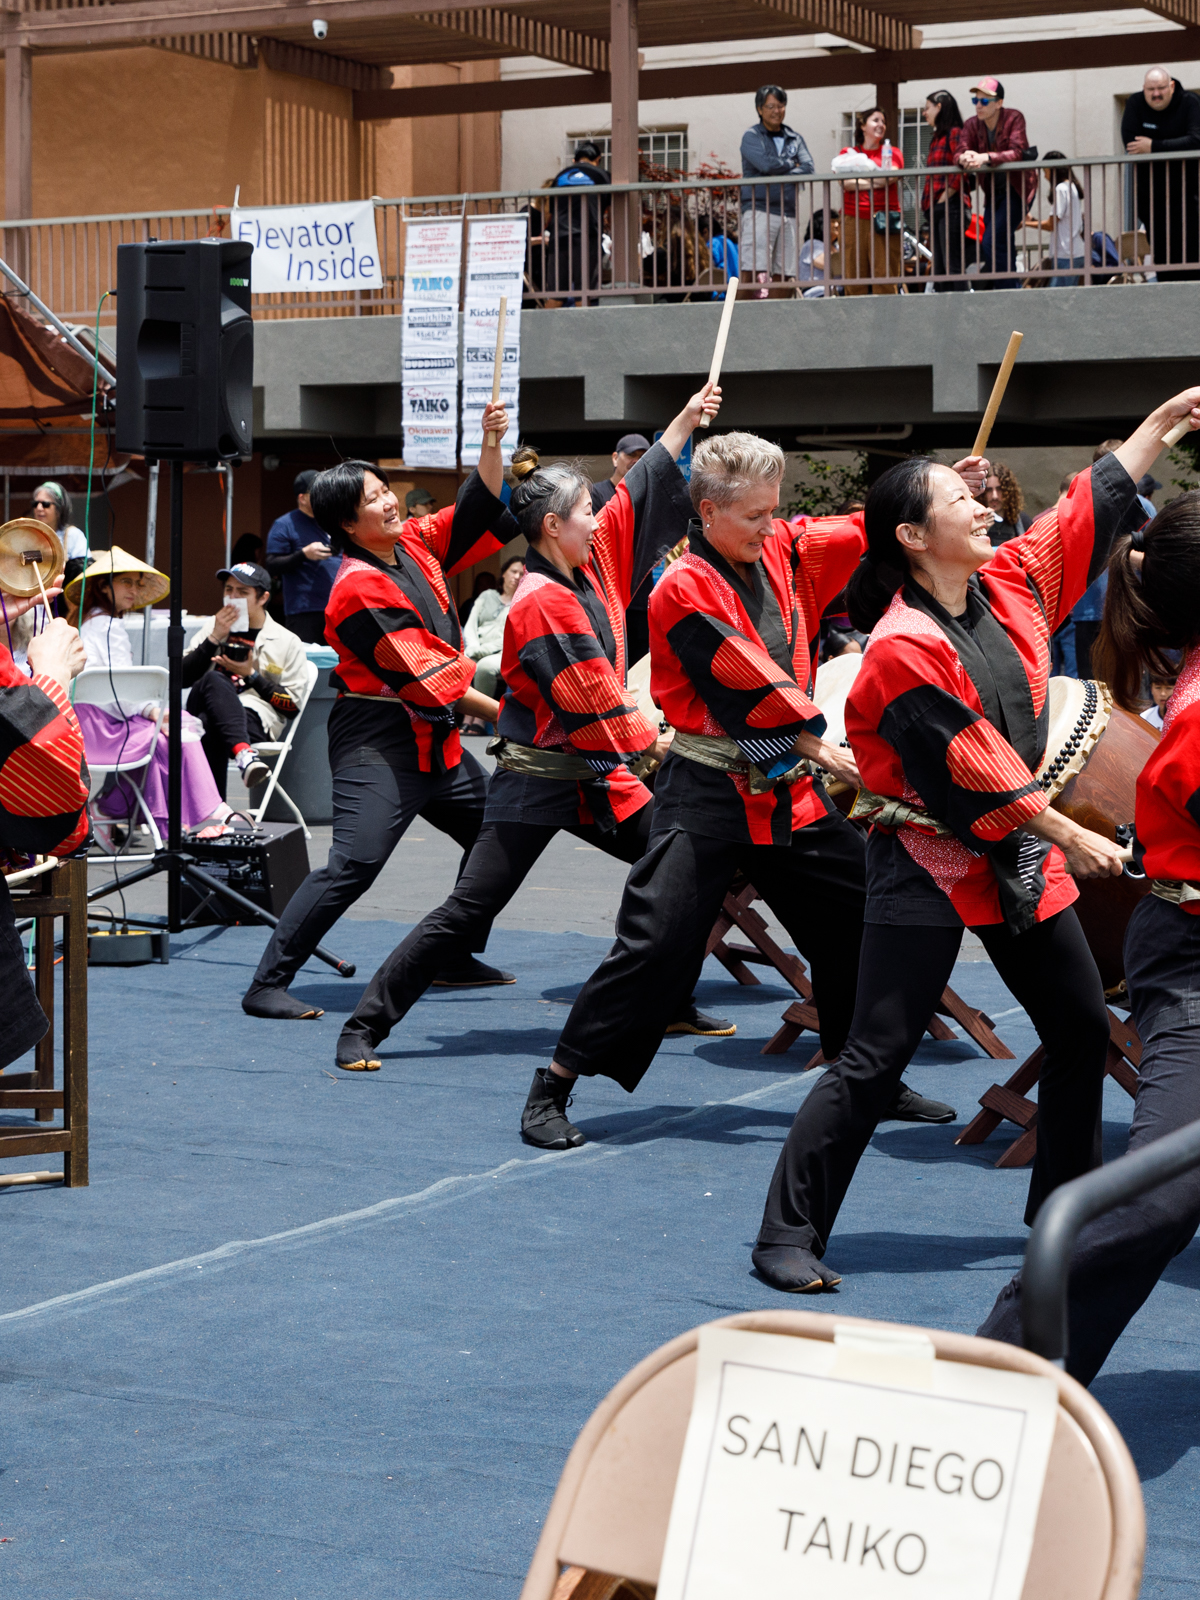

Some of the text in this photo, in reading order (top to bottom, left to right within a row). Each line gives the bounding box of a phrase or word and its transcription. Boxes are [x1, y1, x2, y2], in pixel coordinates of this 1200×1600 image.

[238, 219, 355, 249] Elevator
[287, 247, 375, 282] Inside
[412, 276, 453, 292] TAIKO
[470, 308, 516, 317] Kickfoce
[405, 359, 455, 369] BUDDHISM
[410, 398, 449, 413] TAIKO
[408, 427, 453, 436] Okinawan
[722, 1414, 1005, 1502] SAN DIEGO
[778, 1508, 928, 1576] TAIKO
